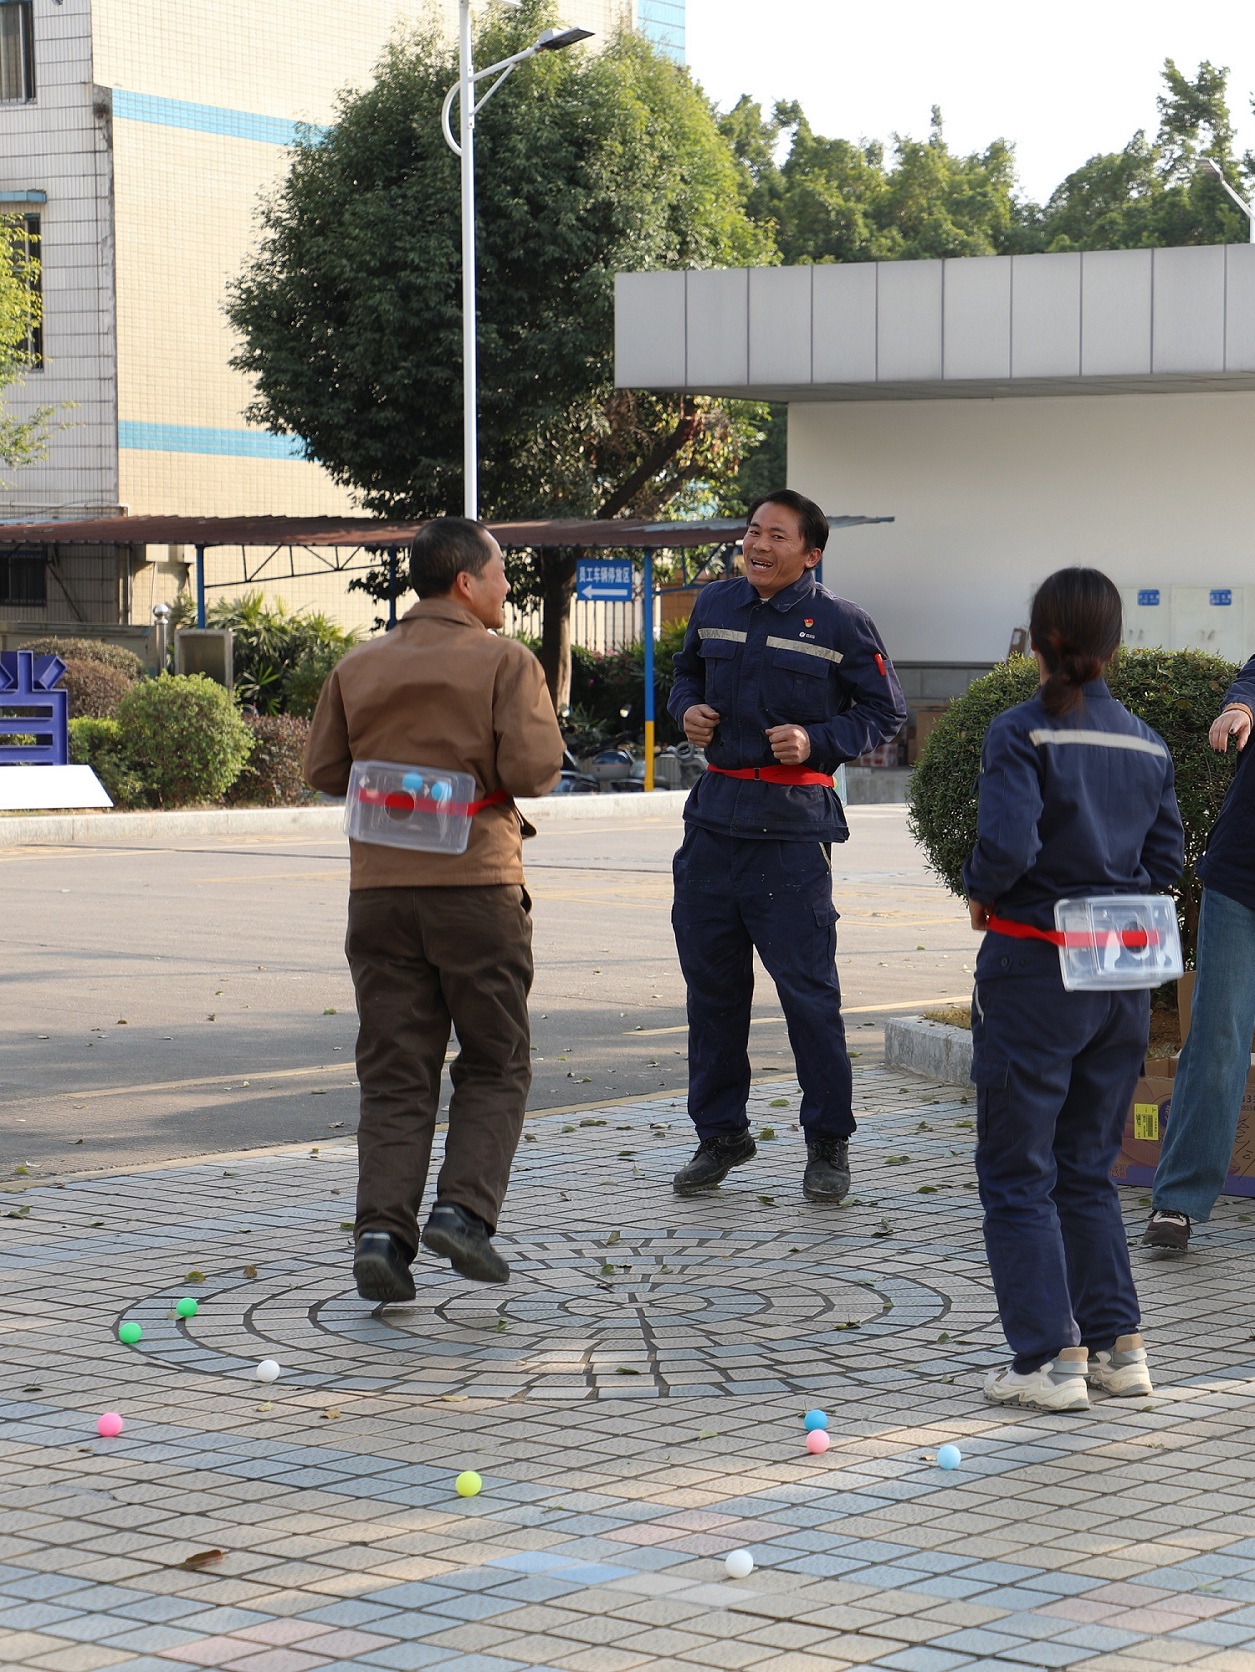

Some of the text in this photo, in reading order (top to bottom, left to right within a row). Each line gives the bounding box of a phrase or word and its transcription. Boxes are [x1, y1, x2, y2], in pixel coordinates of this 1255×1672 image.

[579, 566, 630, 583] 员工车辆停放区
